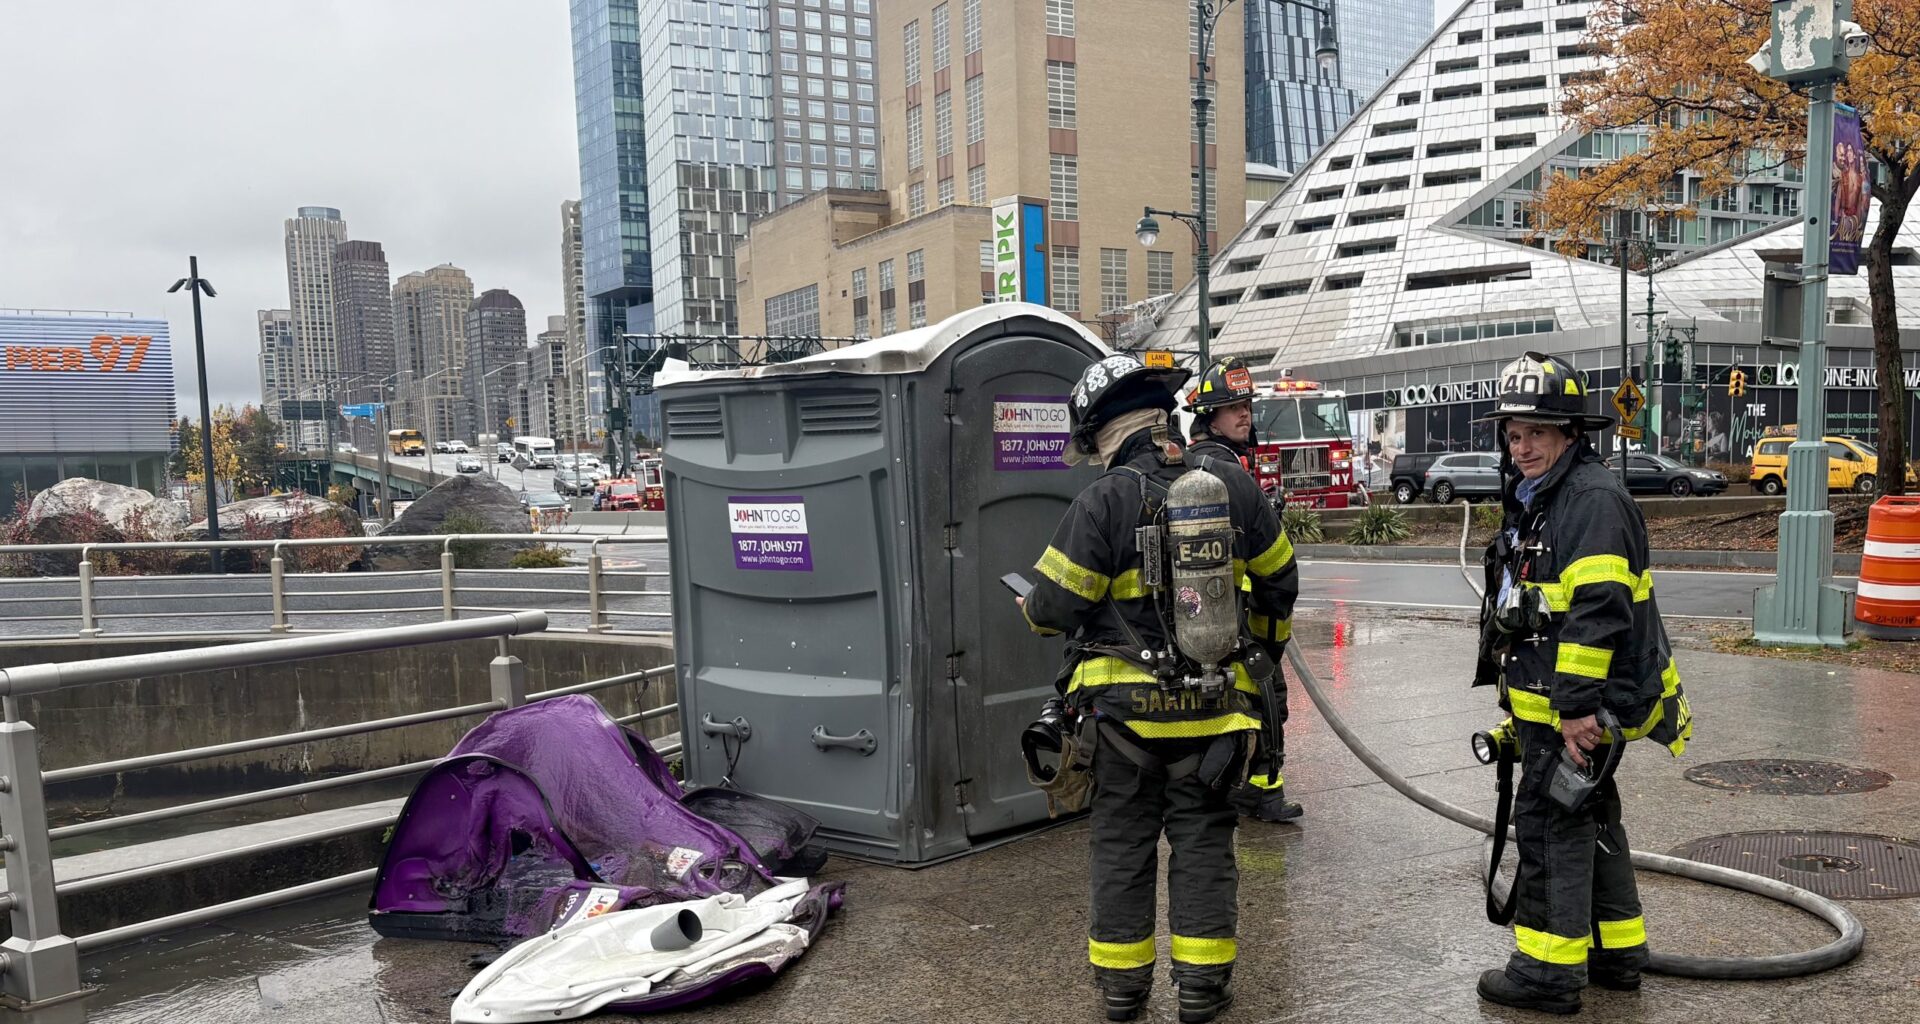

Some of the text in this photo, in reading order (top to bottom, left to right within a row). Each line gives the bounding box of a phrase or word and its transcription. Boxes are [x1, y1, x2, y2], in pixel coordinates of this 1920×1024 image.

[996, 210, 1015, 262] PK
[6, 334, 152, 372] PIER 97
[1503, 374, 1539, 395] 40
[1400, 383, 1438, 406] LOOK
[1439, 381, 1492, 402] DINE-IN
[999, 408, 1066, 421] JOHN TO GO
[1746, 403, 1766, 416] THE
[1000, 440, 1065, 454] 1877.JOHN.977
[1291, 448, 1321, 475] 40
[1331, 473, 1350, 486] NY
[734, 509, 801, 523] JOHN TO GO
[738, 540, 803, 554] 1877.JOHN.977
[1180, 541, 1223, 561] E-40
[741, 555, 804, 565] www.johntogo.com
